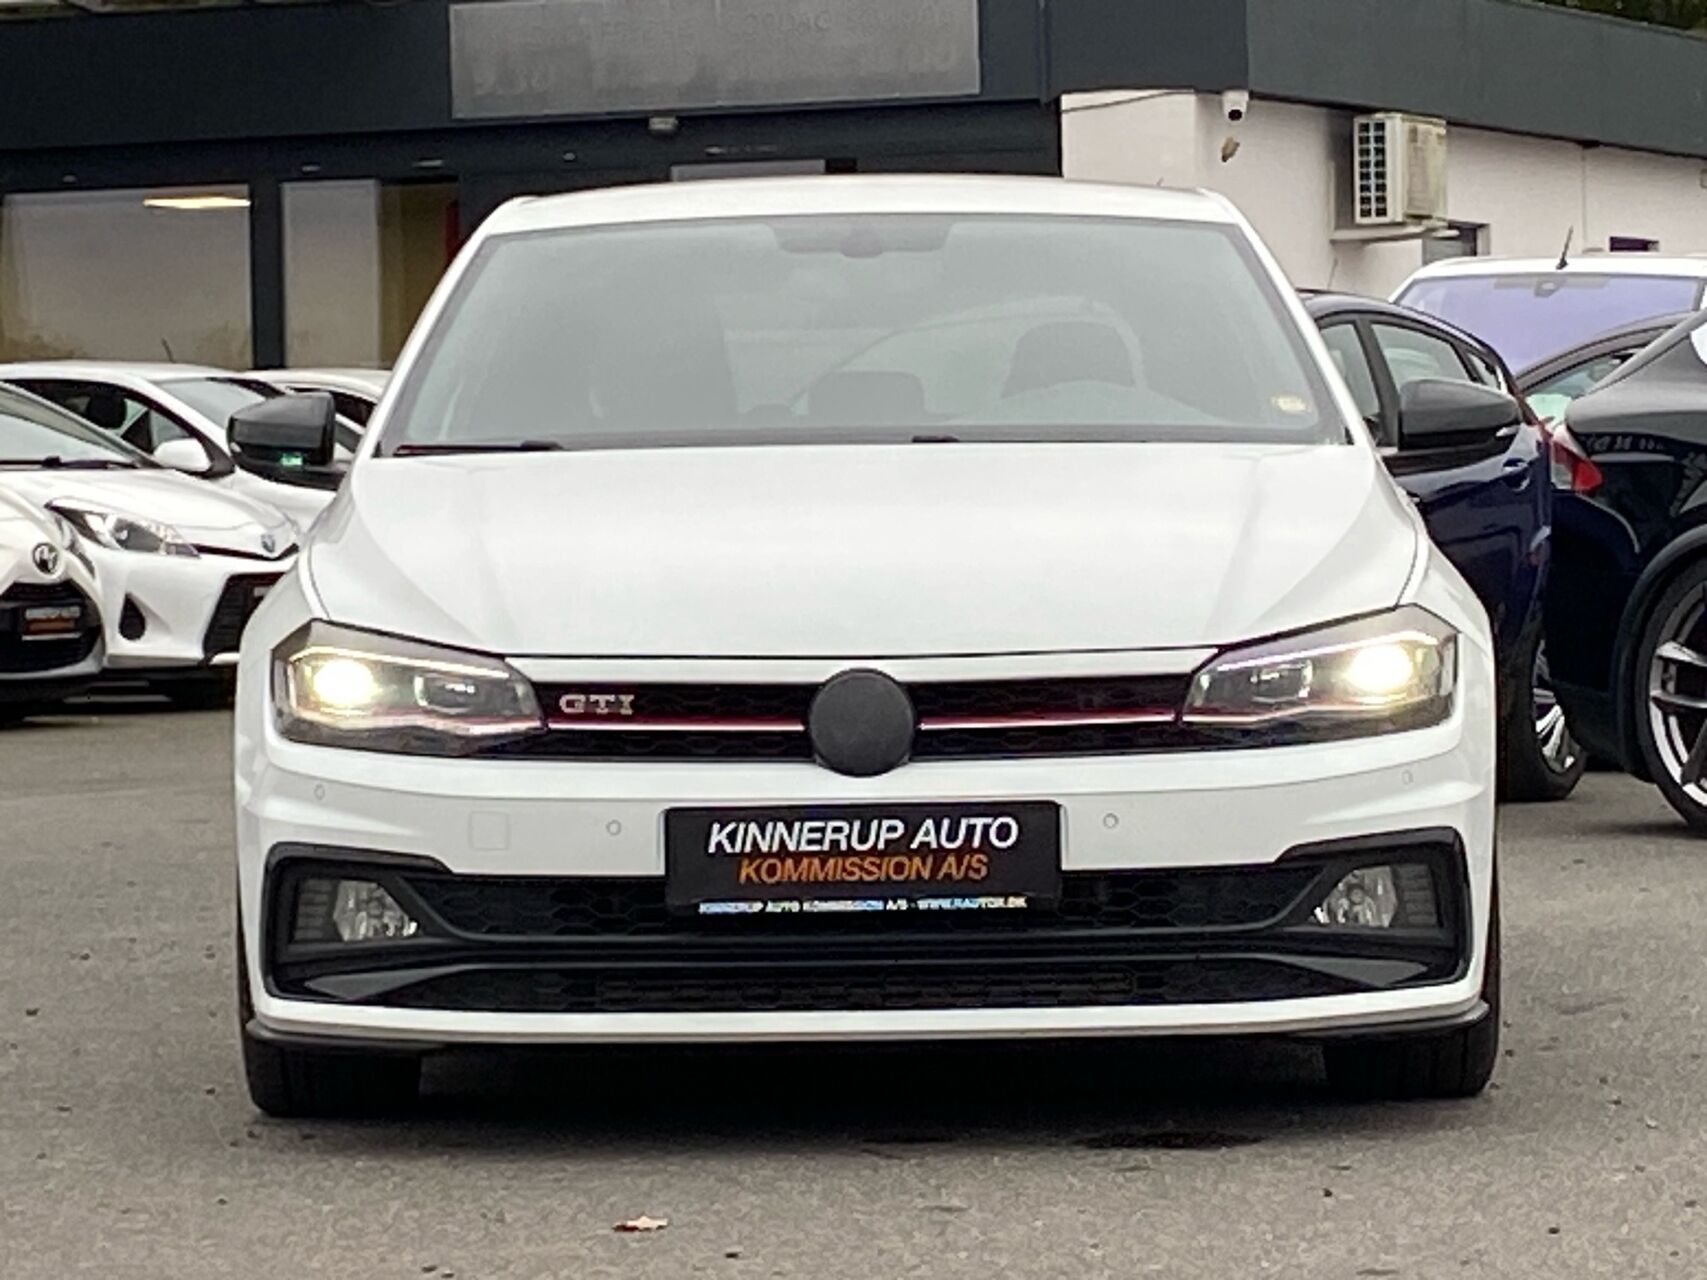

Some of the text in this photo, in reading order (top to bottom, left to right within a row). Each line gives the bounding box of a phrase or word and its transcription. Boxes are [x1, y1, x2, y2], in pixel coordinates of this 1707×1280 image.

[559, 694, 635, 715] GTI
[707, 816, 1019, 853] KINNERUP AUTO
[738, 853, 988, 884] KOMMISSION A/S
